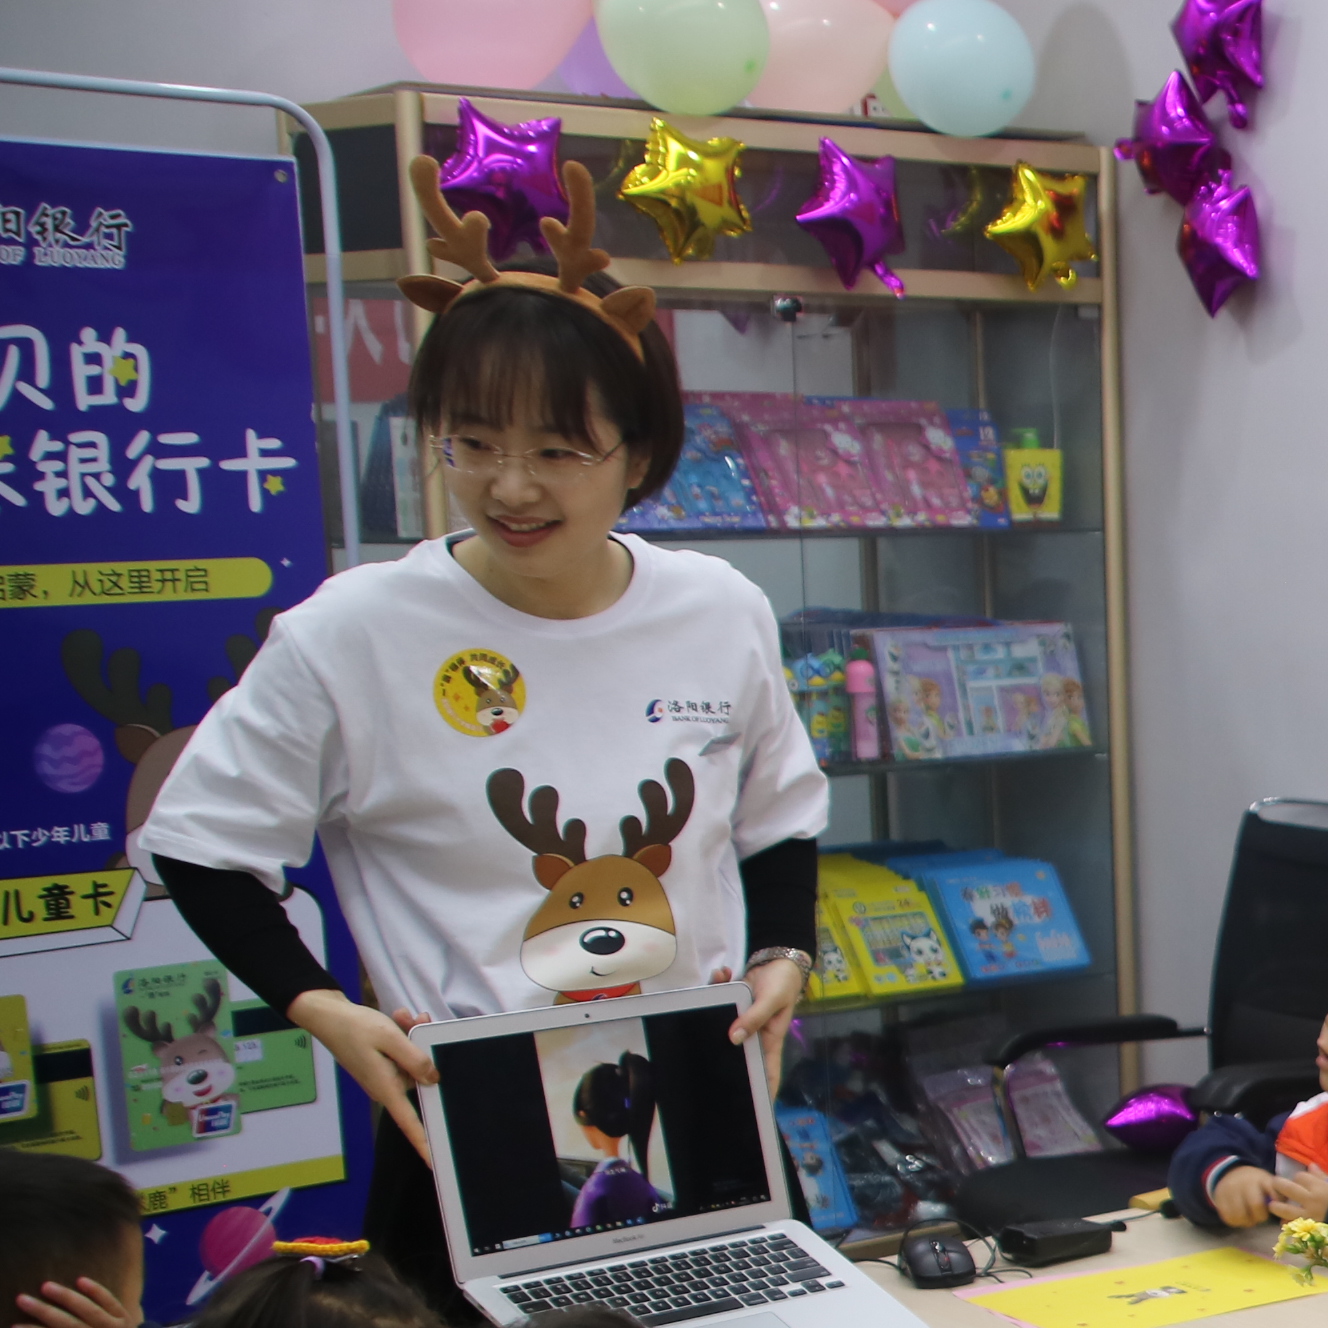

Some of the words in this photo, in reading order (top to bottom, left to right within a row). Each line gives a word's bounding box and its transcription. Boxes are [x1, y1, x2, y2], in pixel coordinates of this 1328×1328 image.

[34, 248, 125, 269] LUOYANG
[667, 700, 732, 715] 洛阳银行
